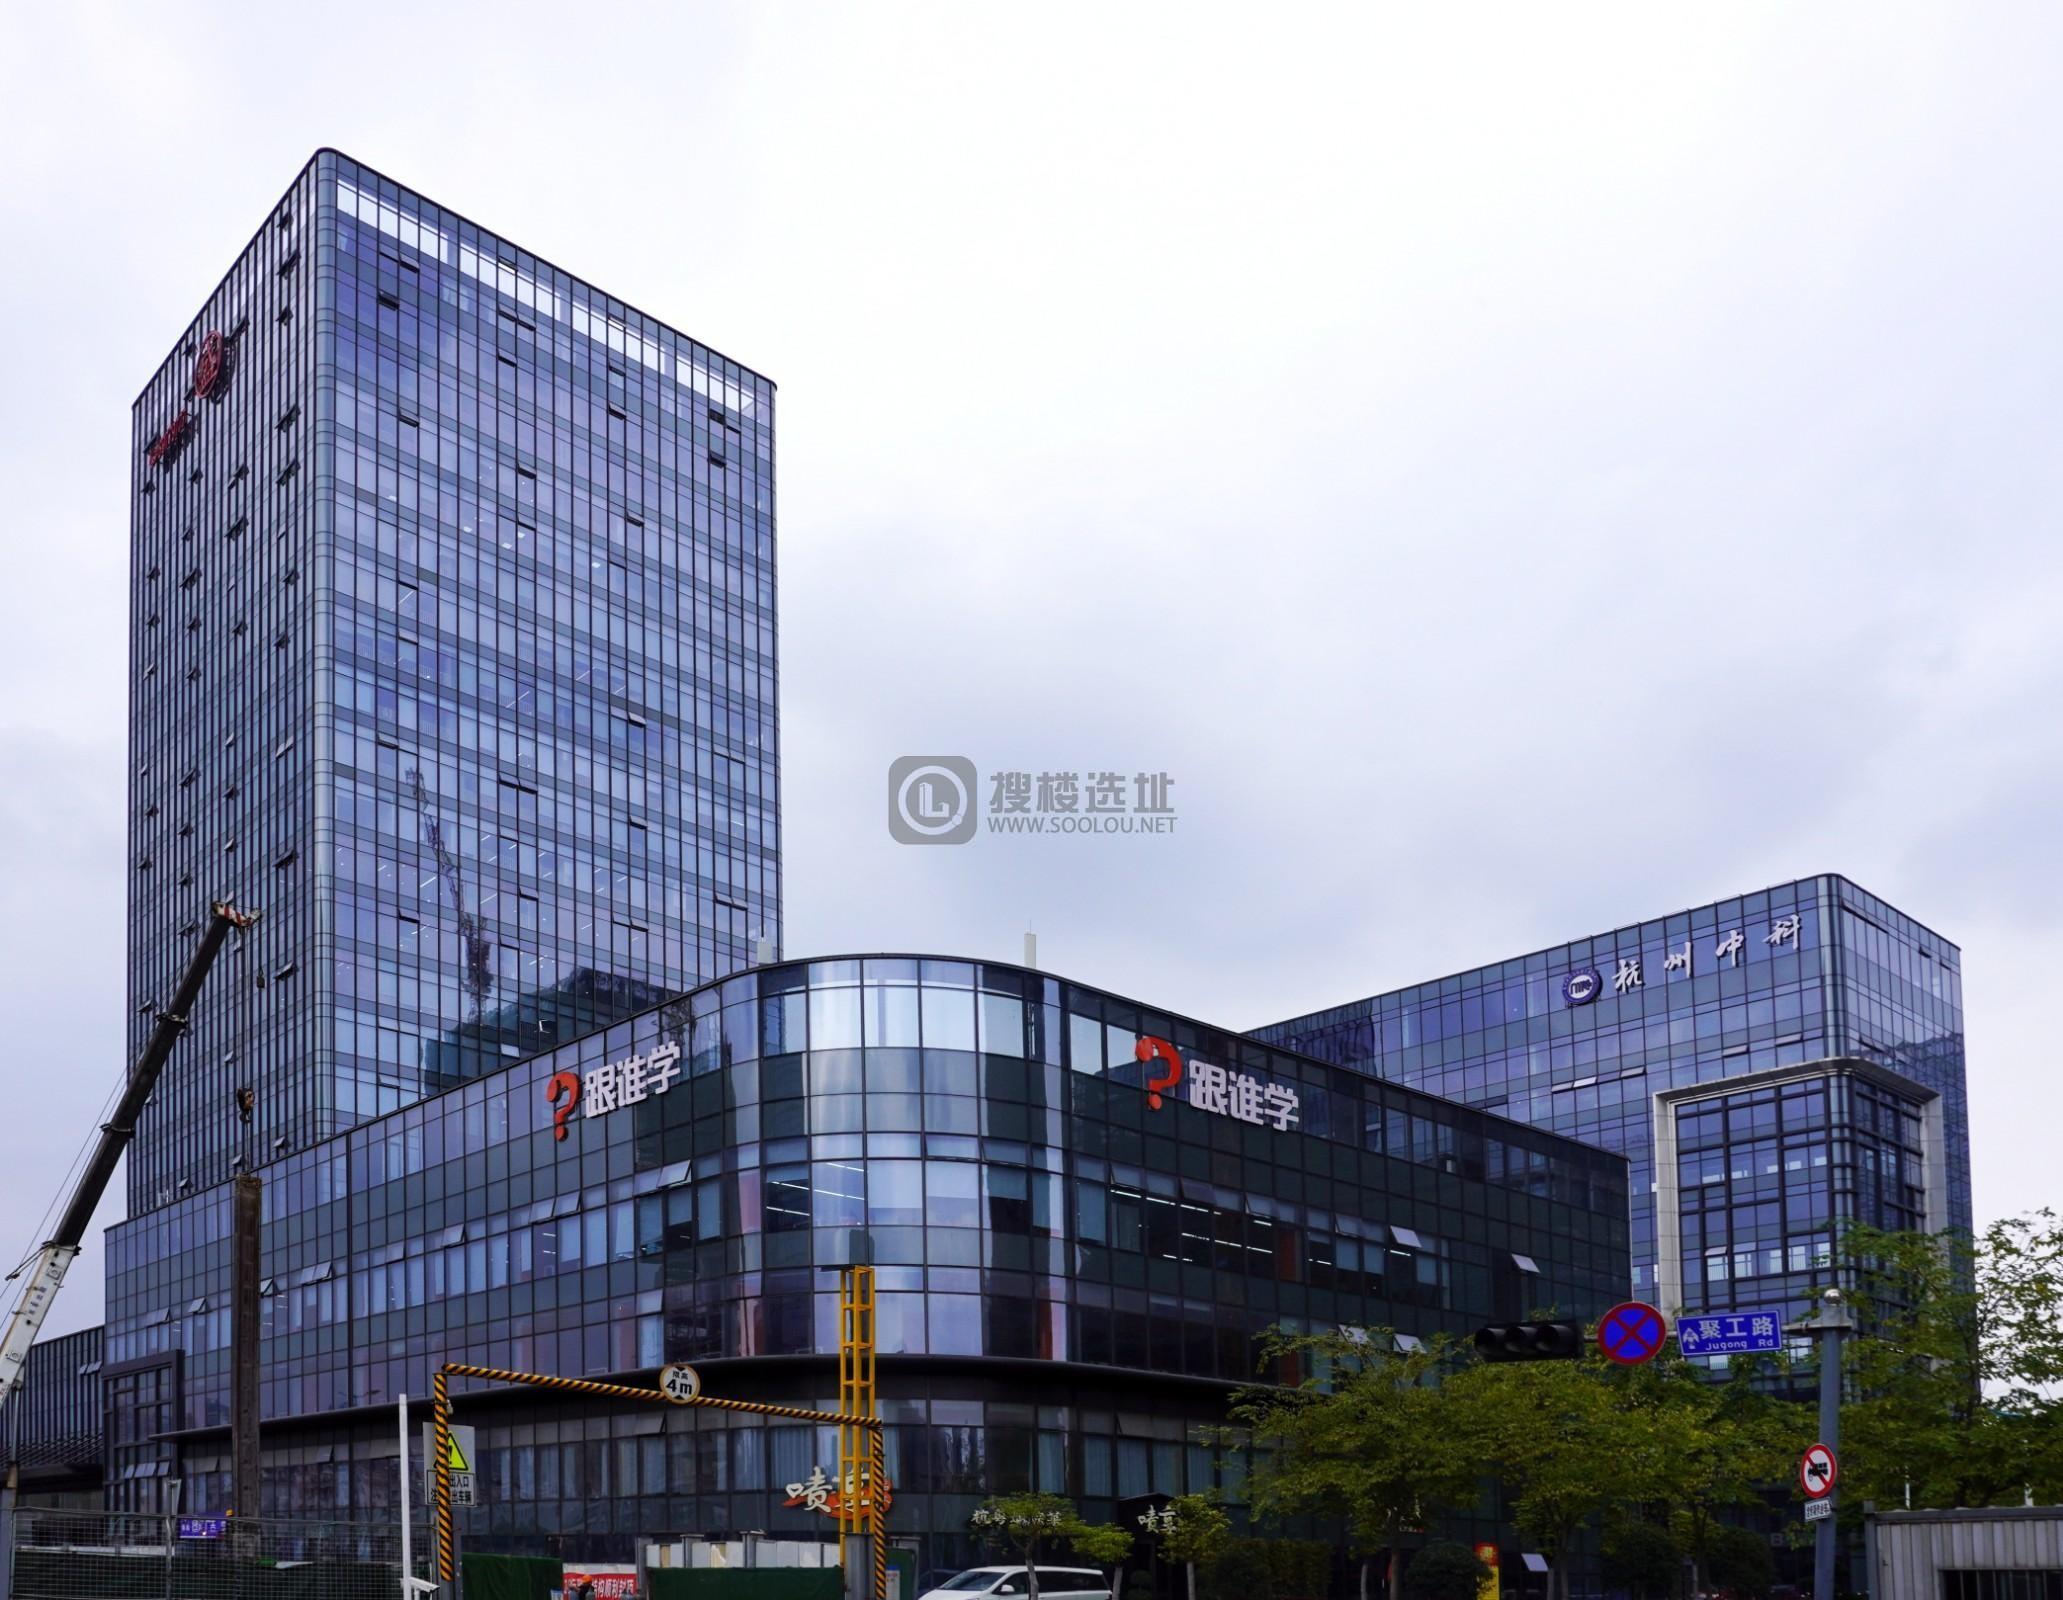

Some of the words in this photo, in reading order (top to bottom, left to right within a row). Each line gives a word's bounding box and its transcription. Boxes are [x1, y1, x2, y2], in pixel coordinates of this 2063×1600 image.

[1612, 914, 1802, 993] 杭州中科
[584, 1041, 681, 1118] 跟谁学
[1189, 1059, 1300, 1132] 跟谁学
[1698, 1316, 1774, 1339] 聚工路
[1705, 1340, 1748, 1351] Jugong
[1758, 1338, 1774, 1347] Rd
[666, 1378, 693, 1395] 4m
